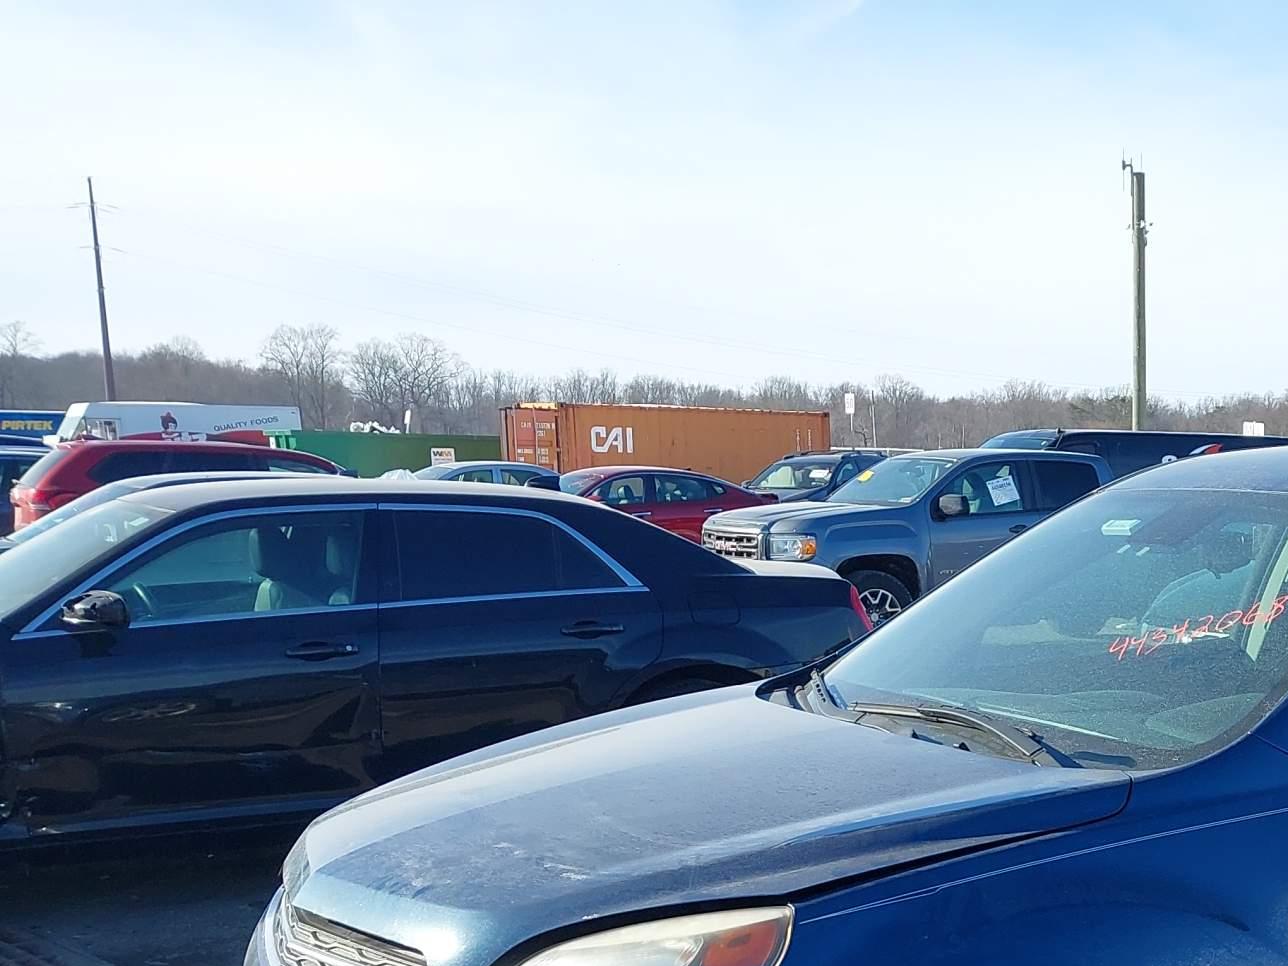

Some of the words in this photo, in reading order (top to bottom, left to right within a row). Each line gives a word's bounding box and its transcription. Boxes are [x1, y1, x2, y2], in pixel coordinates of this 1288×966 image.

[2, 420, 53, 430] PIRTEK
[213, 420, 247, 432] QUALITY
[250, 415, 279, 425] FOODS
[590, 426, 634, 453] CAI
